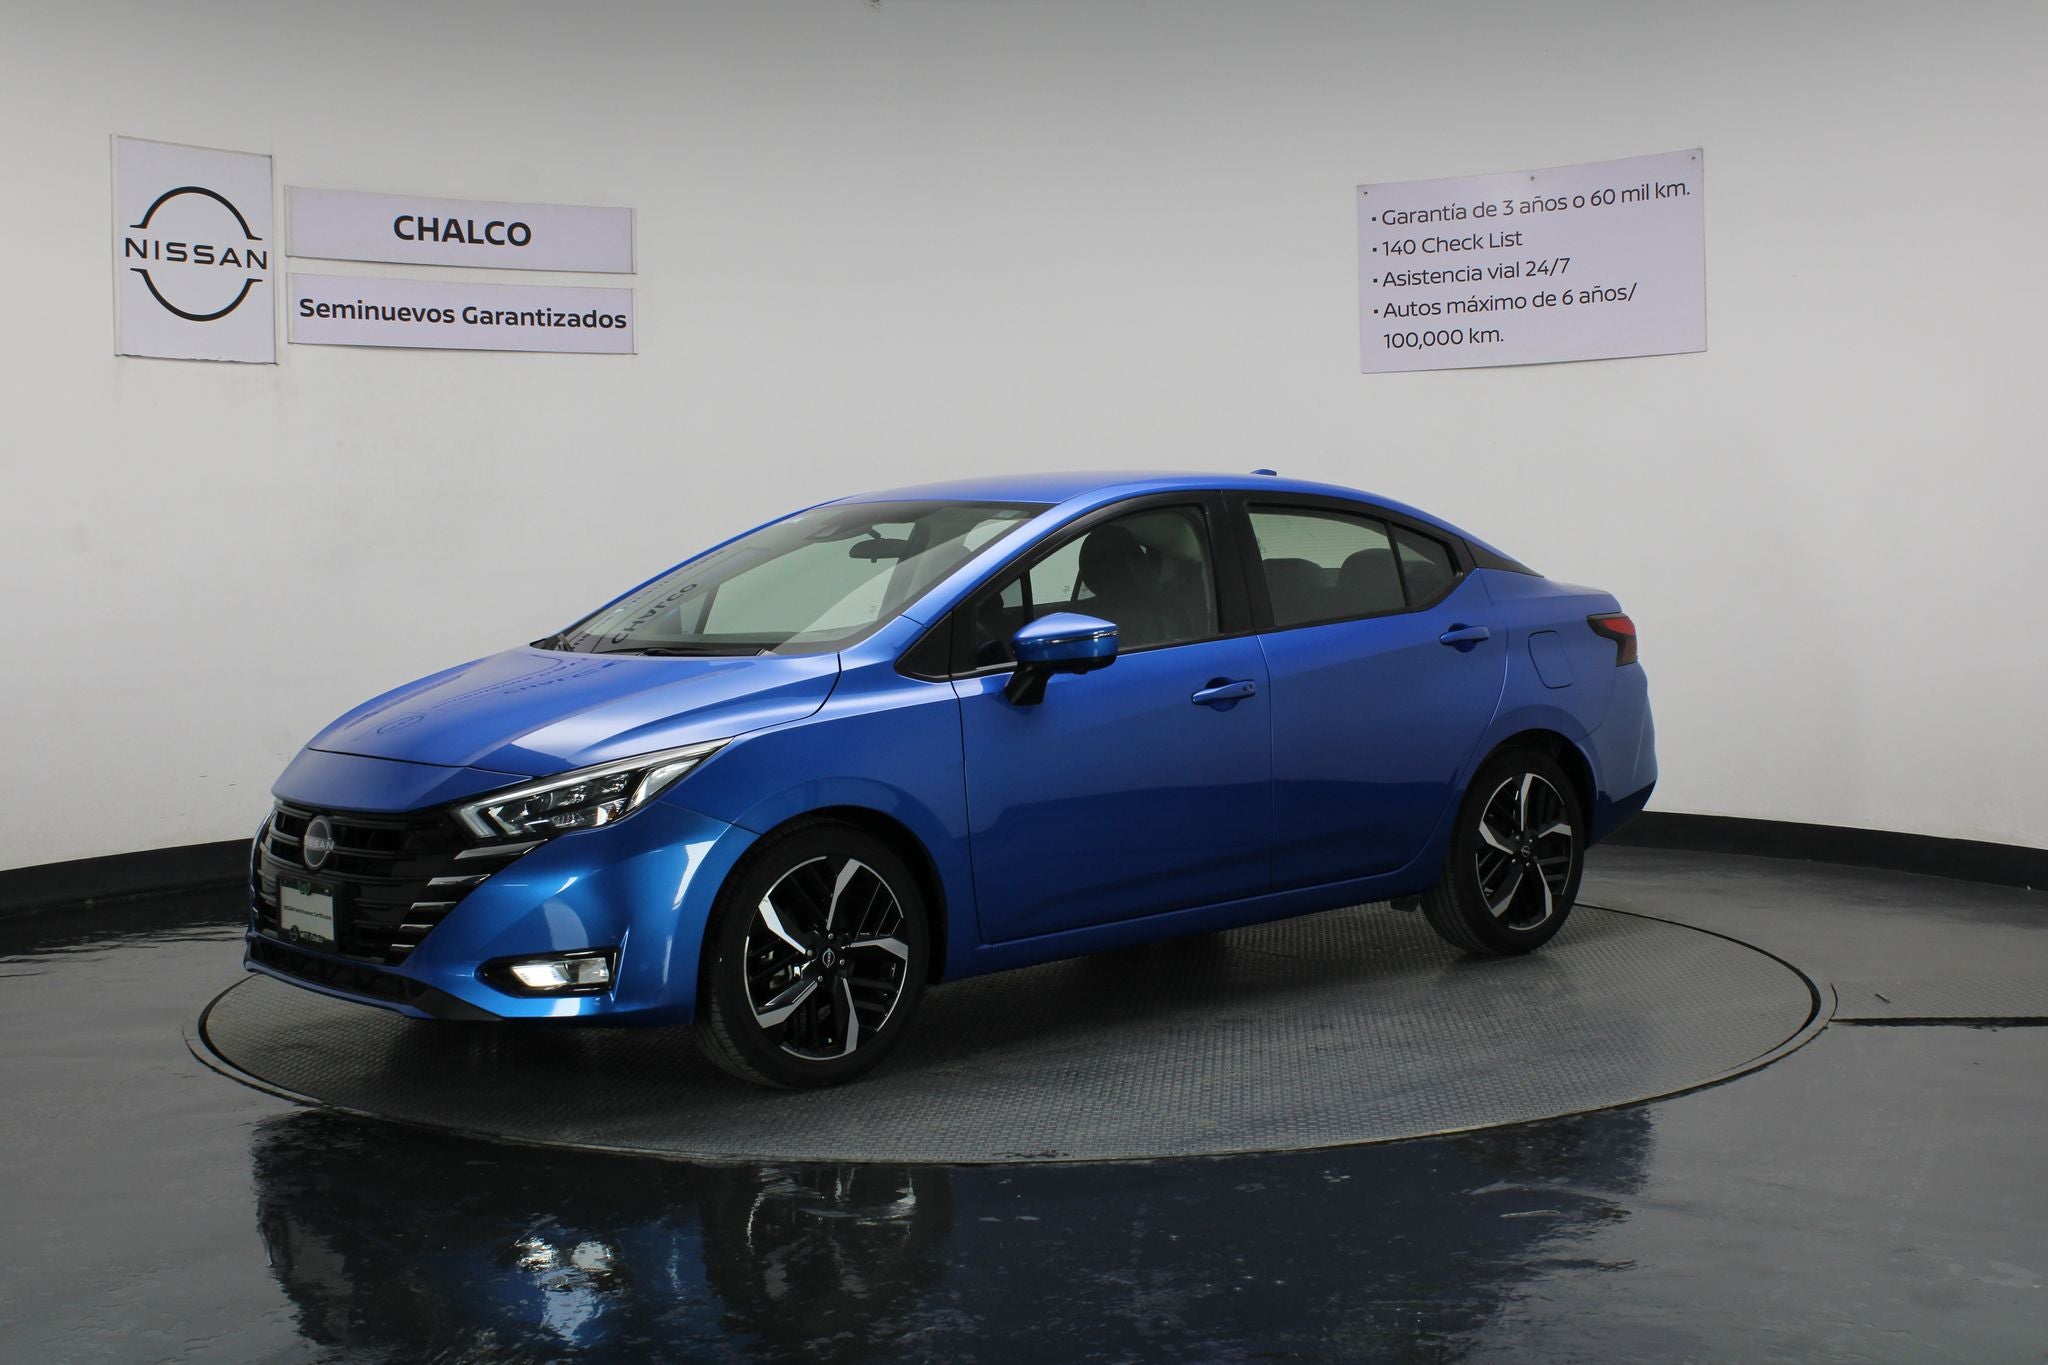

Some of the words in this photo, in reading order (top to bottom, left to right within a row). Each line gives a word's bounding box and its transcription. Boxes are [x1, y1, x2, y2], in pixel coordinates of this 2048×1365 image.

[1381, 202, 1467, 226] Garantía
[1472, 201, 1498, 219] de
[1502, 199, 1514, 216] 3
[1519, 195, 1568, 215] años
[1572, 195, 1586, 209] o
[1590, 188, 1616, 207] 60
[1621, 182, 1650, 204] mil
[1655, 181, 1690, 200] km.
[393, 214, 532, 247] CHALCO
[1381, 239, 1417, 257] 140
[1421, 233, 1484, 254] Check
[1489, 230, 1524, 249] List
[125, 237, 268, 270] NISSAN
[1382, 268, 1483, 288] Asistencia
[1487, 260, 1520, 280] vial
[1525, 257, 1571, 277] 24/7
[299, 298, 456, 324] Seminuevos
[461, 306, 627, 329] Garantizados
[1382, 301, 1442, 319] Autos
[1446, 294, 1528, 315] máximo
[1532, 290, 1557, 308] de
[1561, 288, 1574, 306] 6
[1579, 281, 1638, 305] años/
[1383, 328, 1464, 350] 100,000
[1469, 327, 1505, 345] km.
